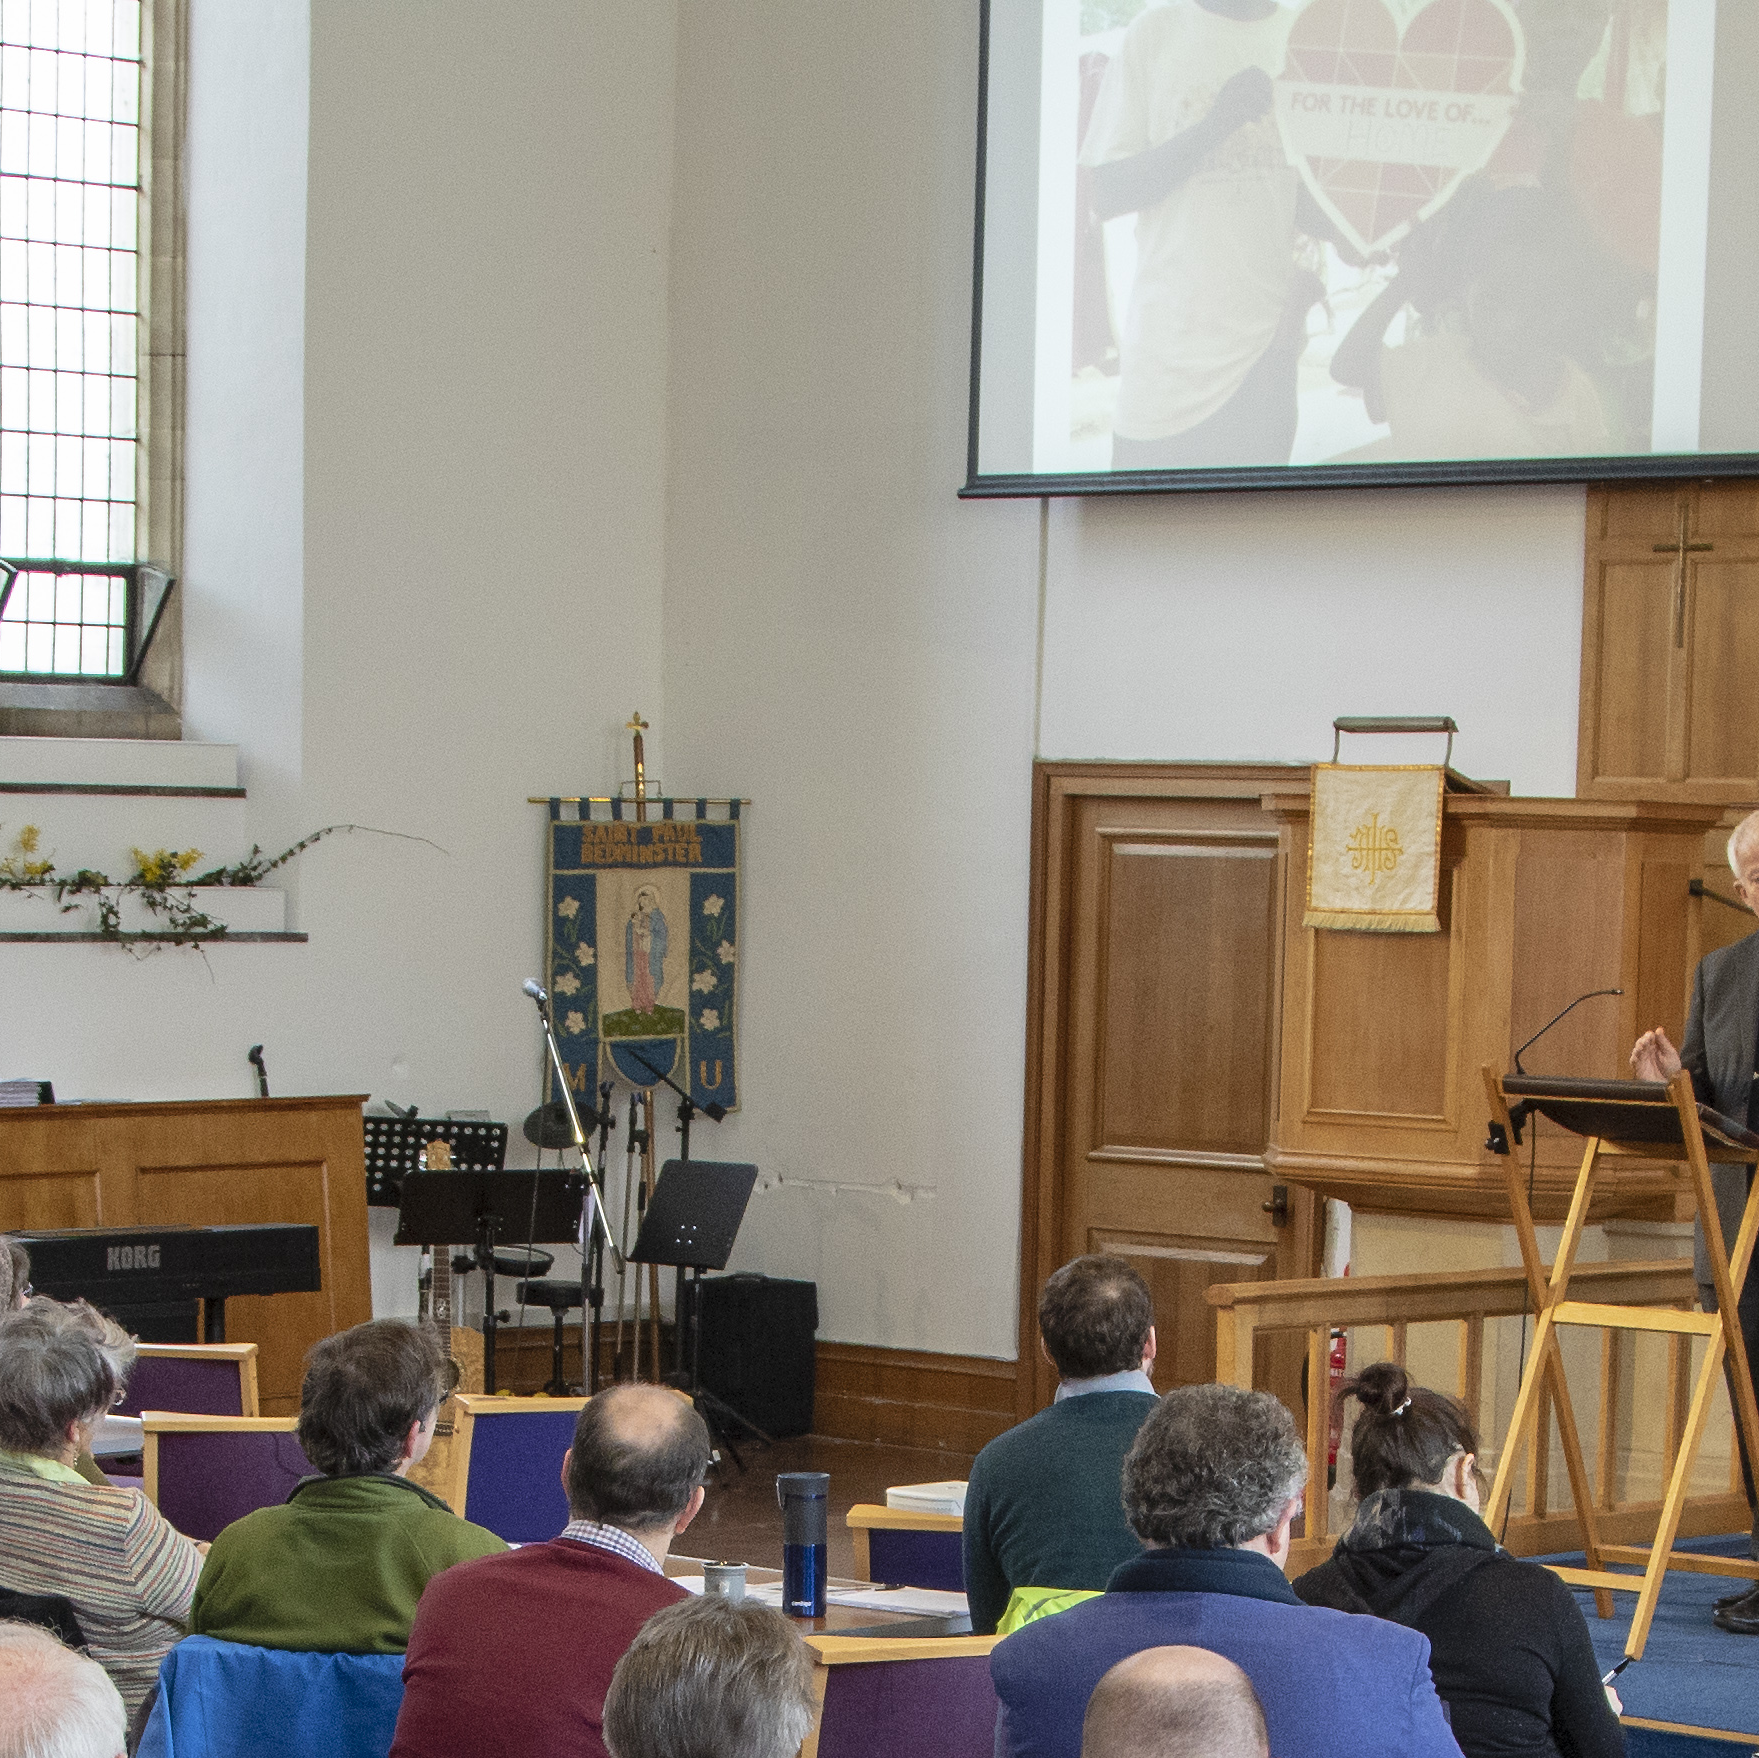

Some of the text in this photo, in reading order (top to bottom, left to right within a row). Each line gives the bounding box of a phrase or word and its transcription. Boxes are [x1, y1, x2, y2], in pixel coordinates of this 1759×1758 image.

[1291, 91, 1491, 125] FOR THE LOVE OF...
[582, 822, 703, 843] SAINT PAUL
[699, 1059, 723, 1090] U
[106, 1245, 161, 1271] KORG
